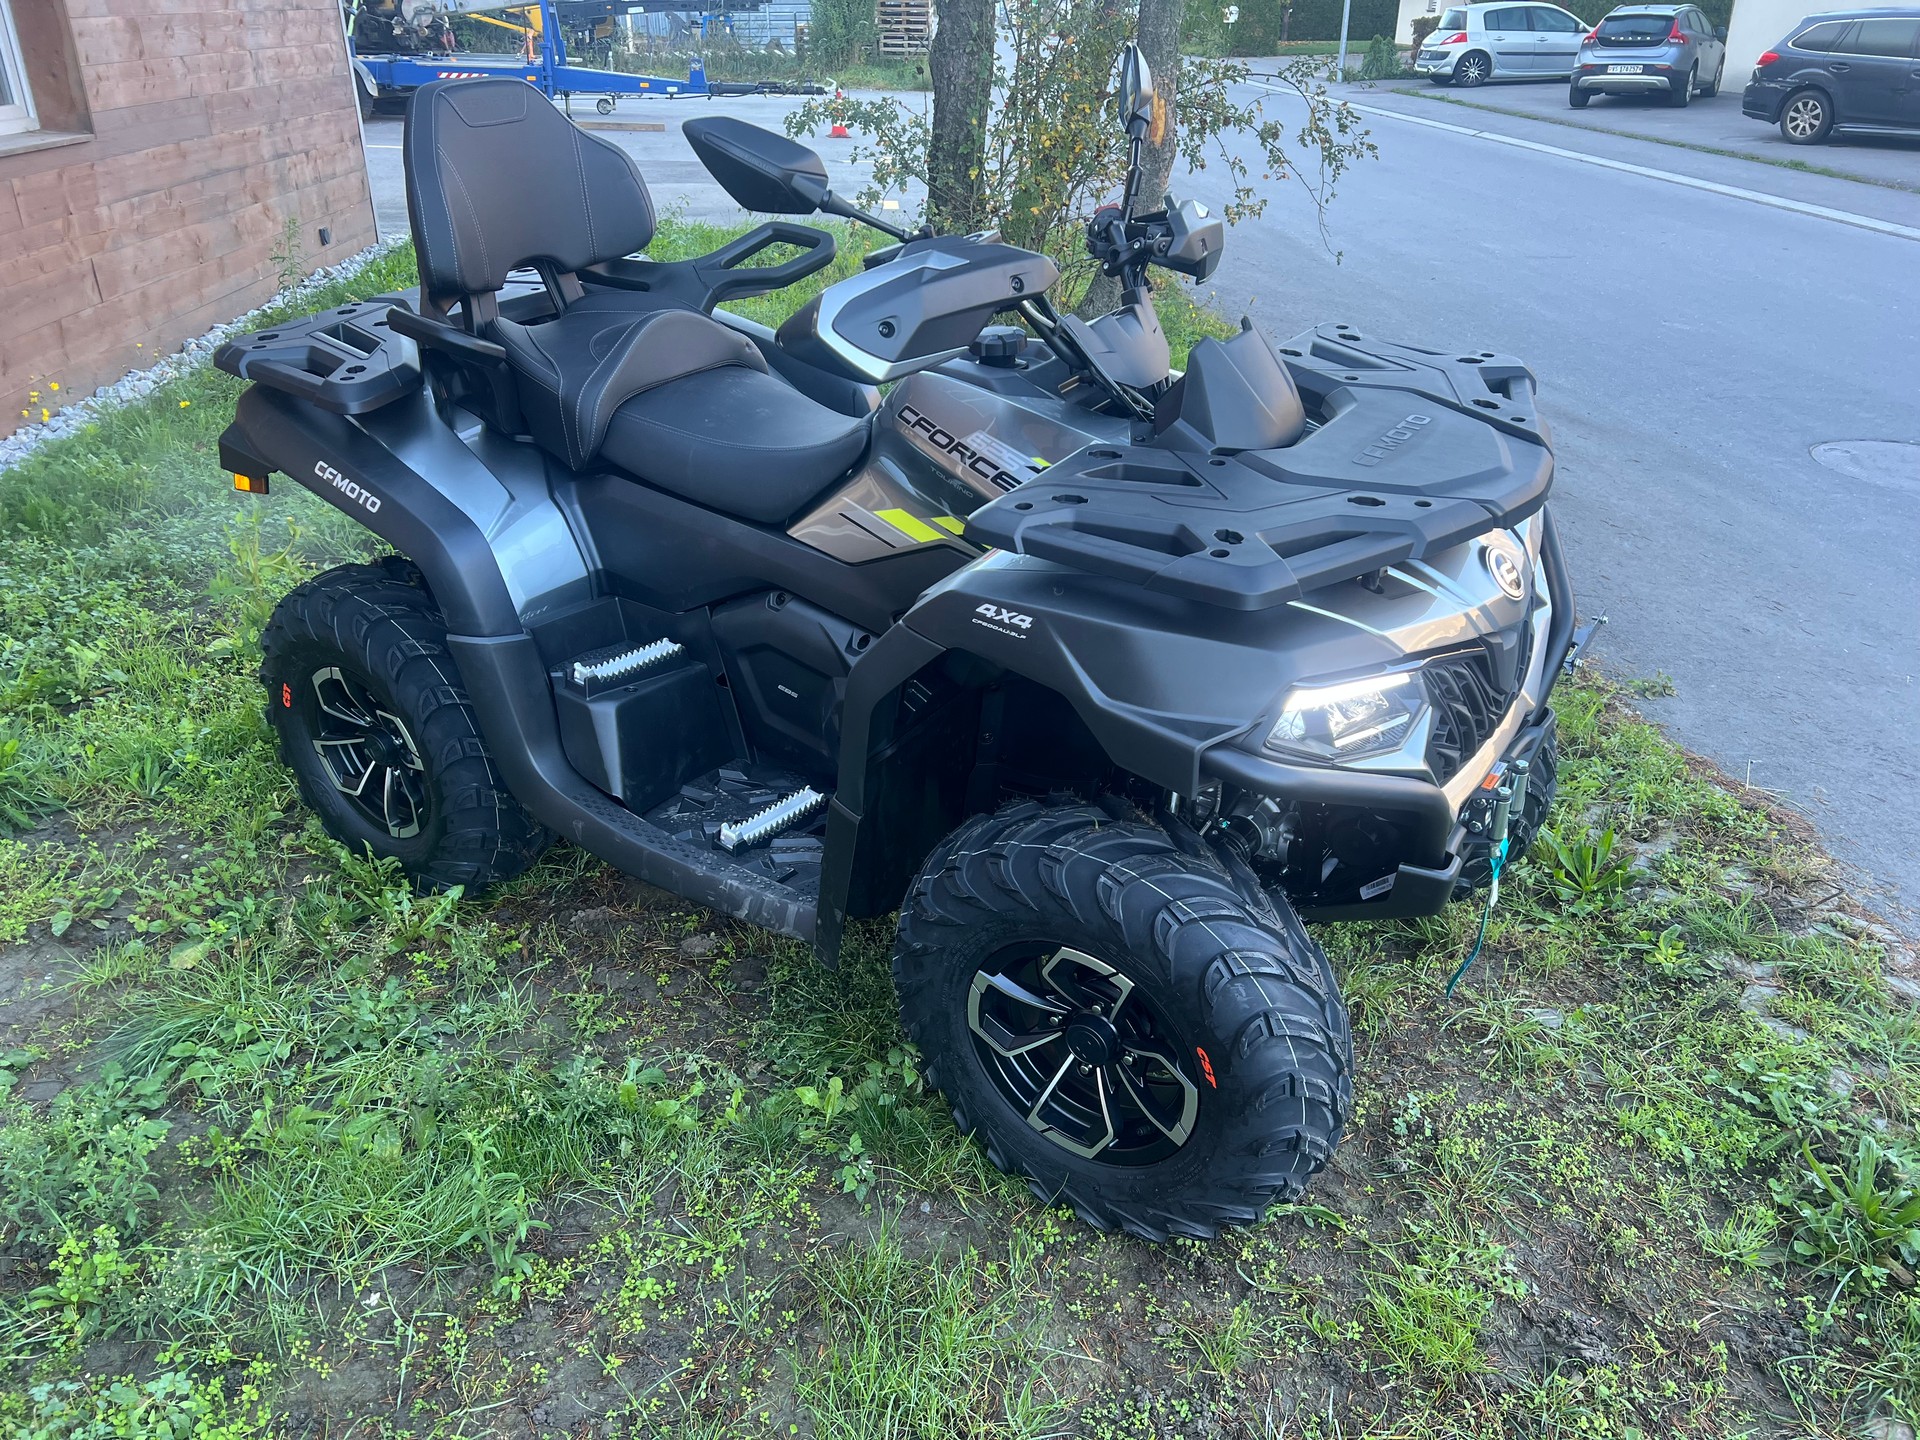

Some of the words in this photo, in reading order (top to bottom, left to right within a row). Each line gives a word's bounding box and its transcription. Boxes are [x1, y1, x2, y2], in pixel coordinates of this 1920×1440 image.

[897, 404, 1023, 492] CFORCE
[1352, 414, 1432, 467] CFMOTO
[314, 460, 381, 513] CFMOTO
[282, 682, 291, 708] CST
[1196, 1046, 1217, 1089] CST
